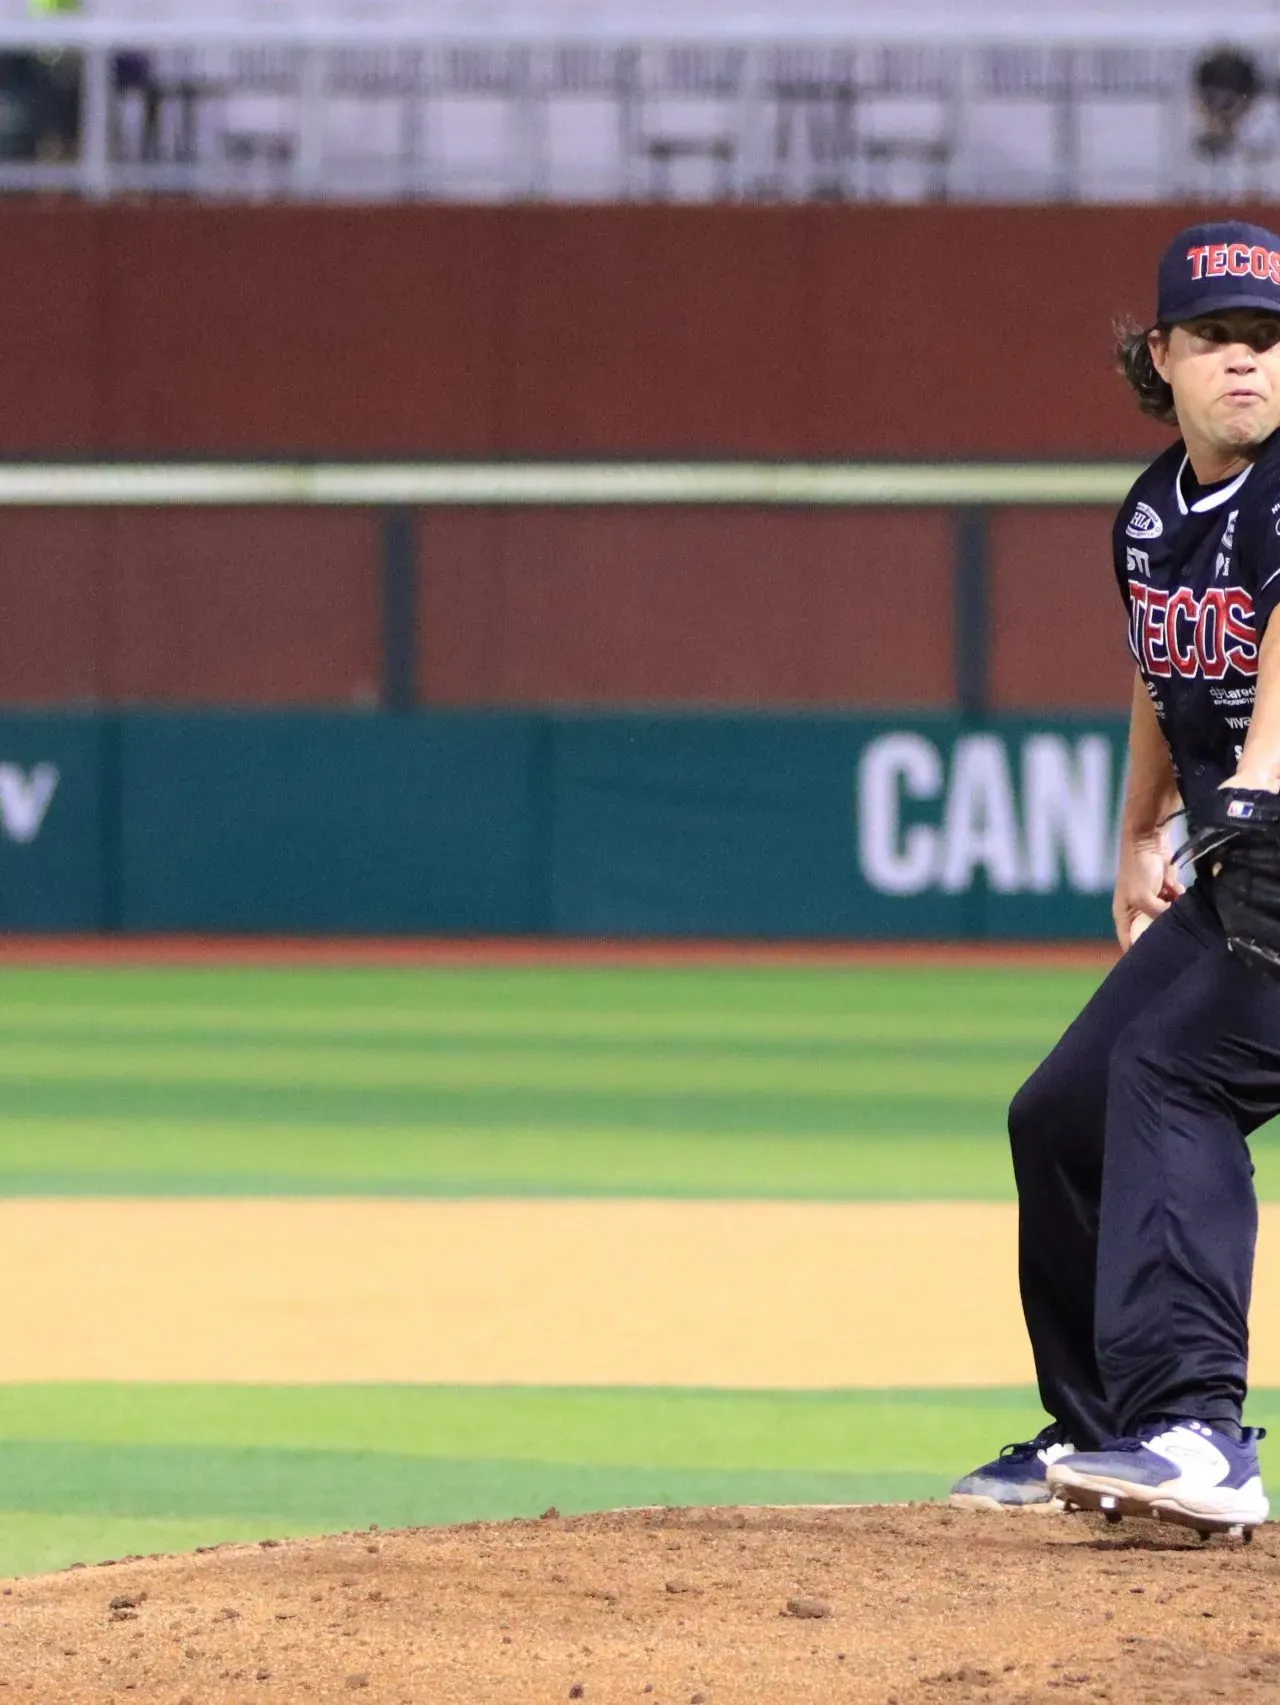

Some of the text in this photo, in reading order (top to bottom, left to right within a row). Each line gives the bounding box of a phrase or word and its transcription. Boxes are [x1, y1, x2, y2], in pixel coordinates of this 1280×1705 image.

[1128, 579, 1258, 680] TECOS
[1222, 684, 1257, 699] Lared
[857, 731, 1128, 895] CAN
